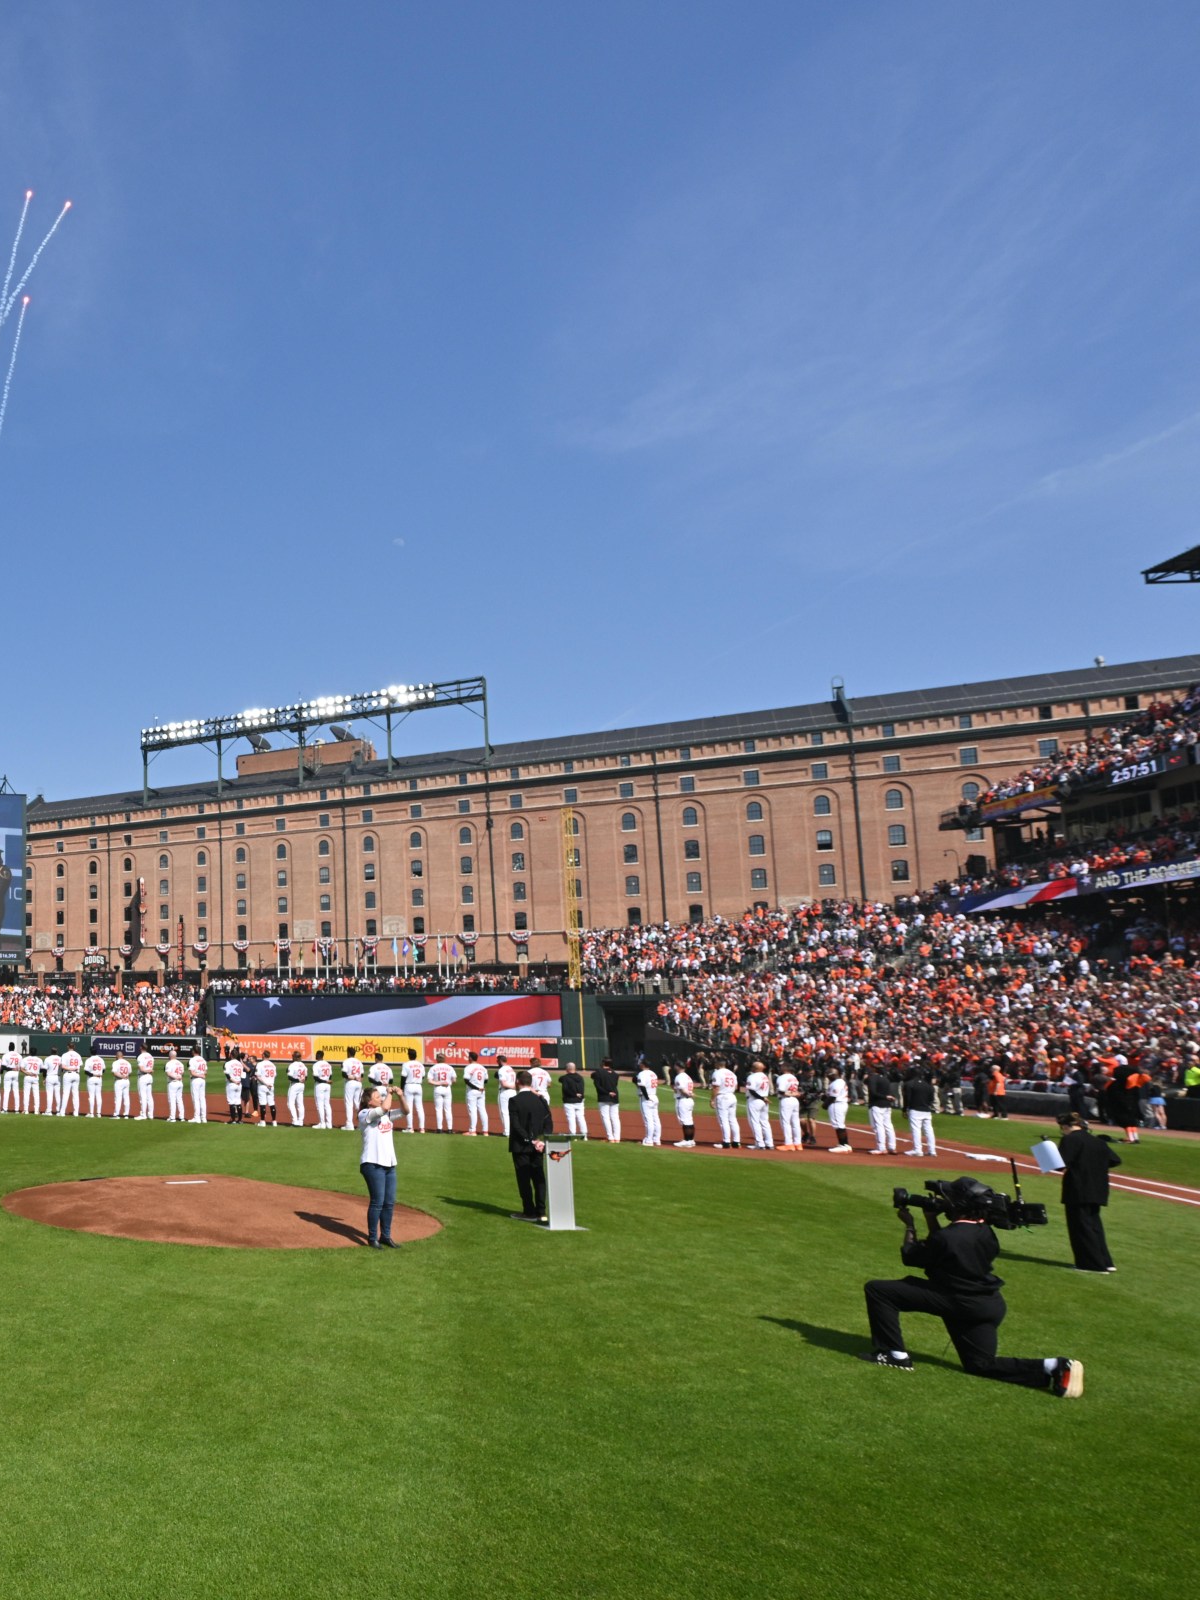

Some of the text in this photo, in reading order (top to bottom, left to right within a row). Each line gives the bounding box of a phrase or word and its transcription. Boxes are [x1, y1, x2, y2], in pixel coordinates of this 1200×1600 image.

[1111, 760, 1157, 783] 2:57:51
[1095, 875, 1120, 888] AND
[1121, 870, 1148, 884] THE
[496, 1047, 535, 1055] CARROLL
[120, 1066, 128, 1074] 50
[197, 1063, 205, 1071] 40
[351, 1066, 361, 1074] 24
[233, 1068, 241, 1076] 39
[321, 1069, 330, 1077] 30
[380, 1072, 388, 1080] 21
[413, 1069, 421, 1078] 12
[477, 1072, 482, 1080] 6
[438, 1072, 447, 1081] 13
[537, 1077, 544, 1086] 7
[724, 1077, 734, 1087] 53
